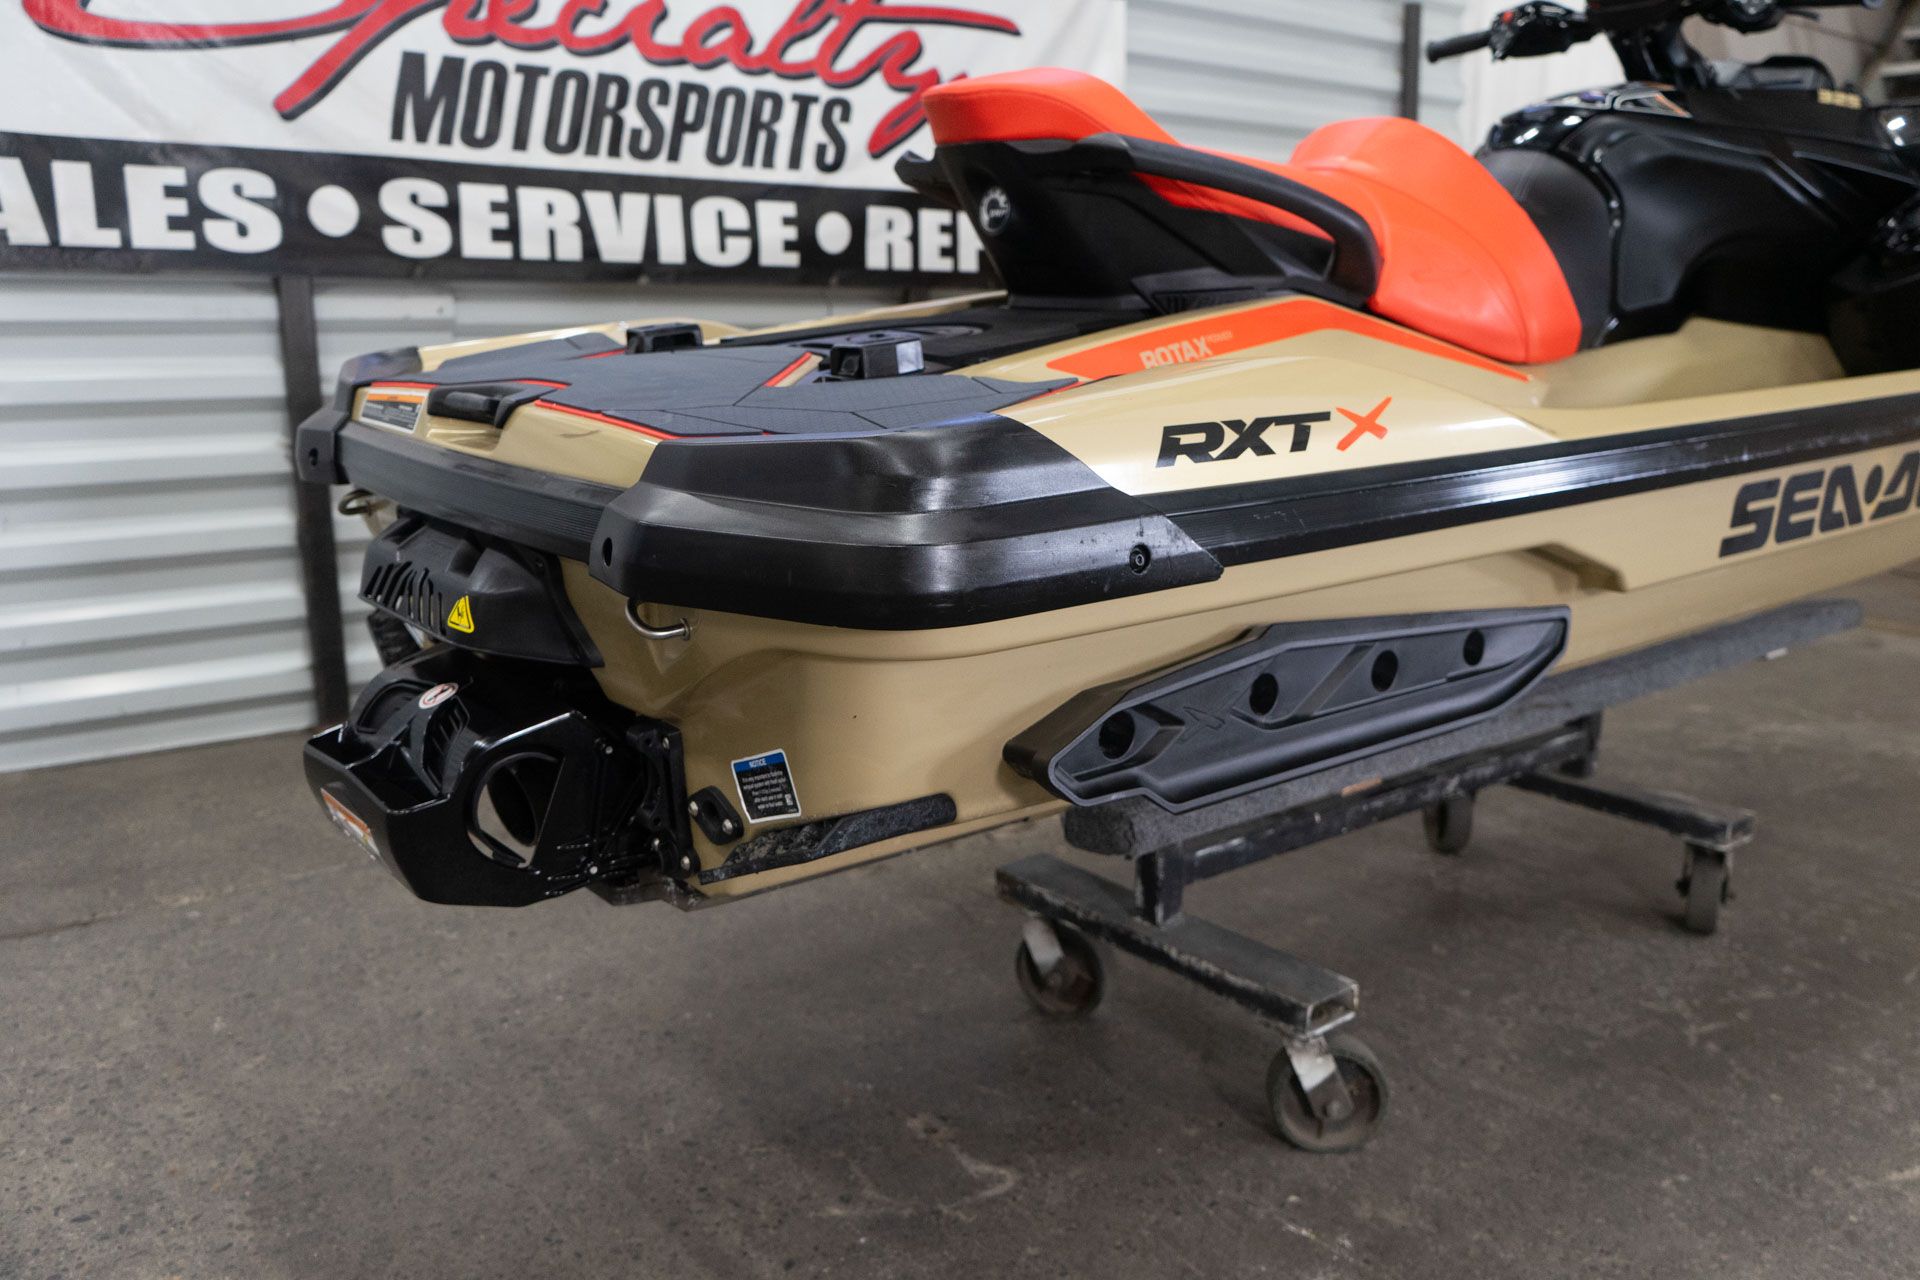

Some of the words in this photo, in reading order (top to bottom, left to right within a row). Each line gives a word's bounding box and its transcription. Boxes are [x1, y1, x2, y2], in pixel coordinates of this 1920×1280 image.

[22, 0, 1021, 159] pecialty
[390, 51, 852, 174] MOTORSPORTS
[379, 176, 802, 269] SERVICE
[1140, 336, 1213, 369] ROTAX
[1155, 410, 1332, 468] RXT
[1335, 396, 1393, 452] X
